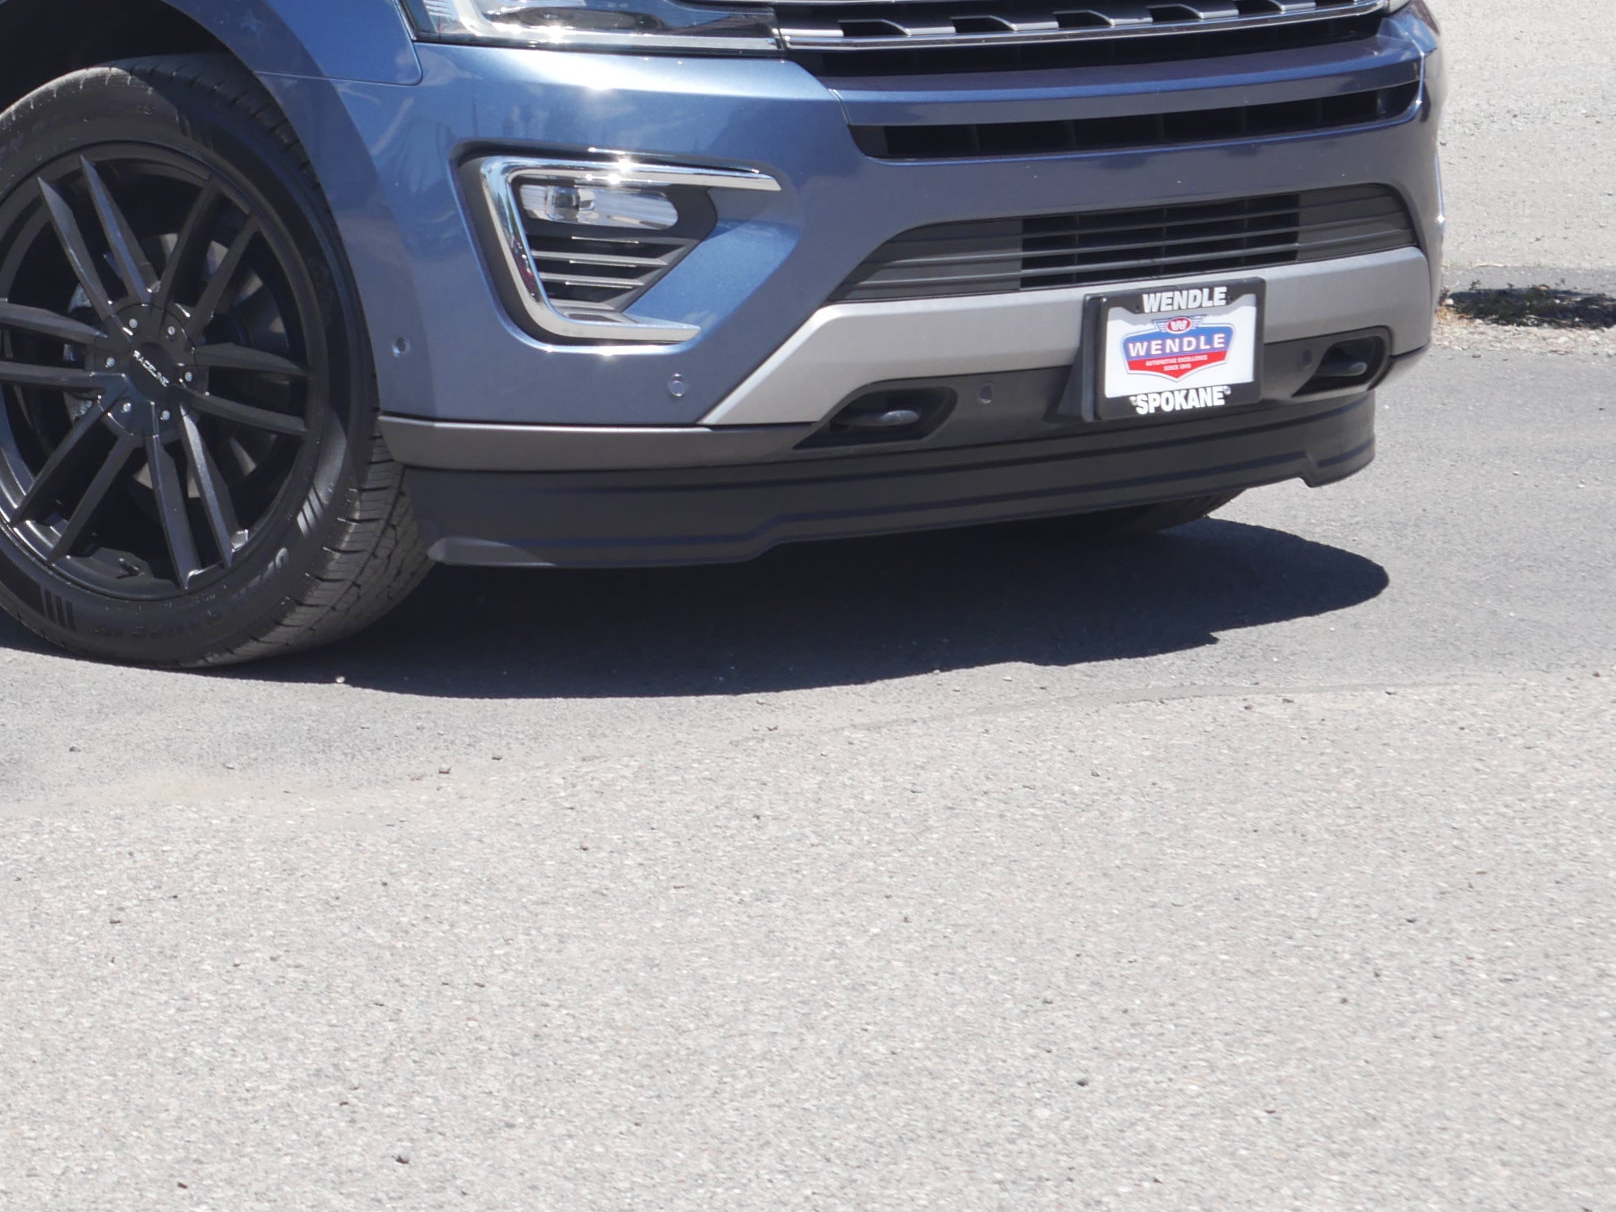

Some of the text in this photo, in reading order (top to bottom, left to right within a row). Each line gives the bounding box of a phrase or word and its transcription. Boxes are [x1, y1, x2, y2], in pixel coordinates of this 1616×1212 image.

[1142, 286, 1227, 314] WENDLE
[1127, 333, 1226, 357] WENDLE
[1135, 386, 1226, 415] SPOKANE
